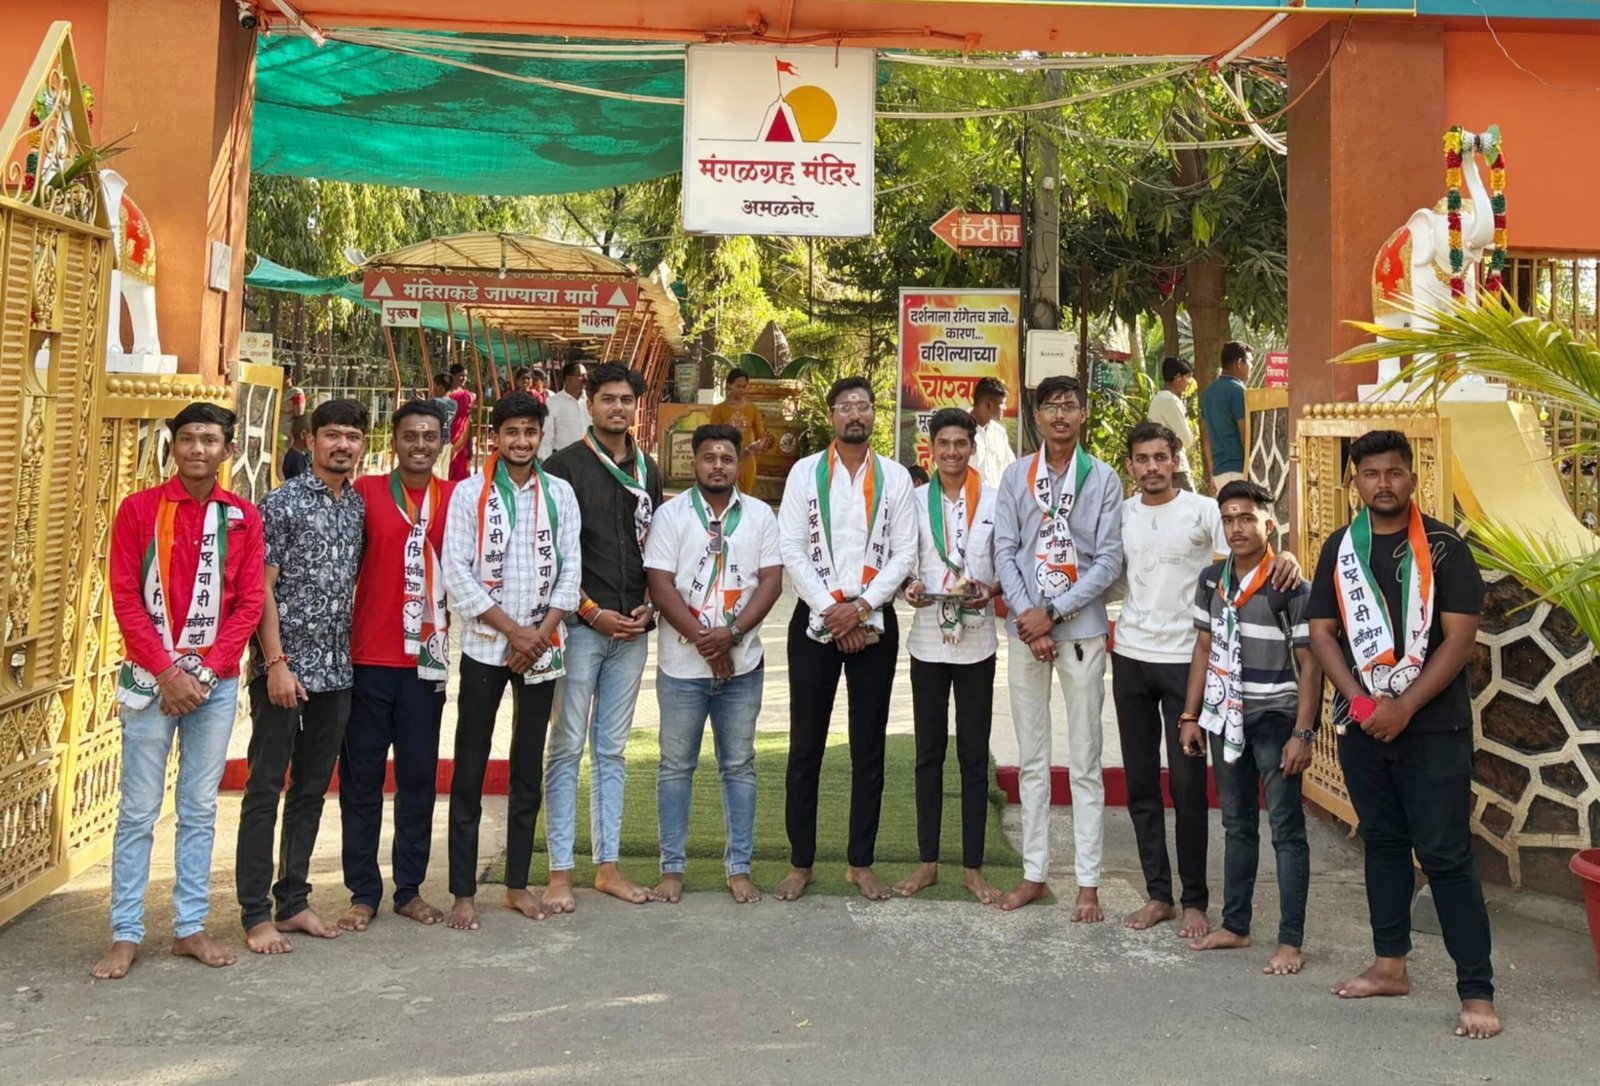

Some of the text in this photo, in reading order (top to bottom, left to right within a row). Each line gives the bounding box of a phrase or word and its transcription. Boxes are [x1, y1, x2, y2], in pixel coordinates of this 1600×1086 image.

[698, 153, 861, 186] मंगळग्रह मंदिर
[741, 195, 819, 218] अमळनेर
[403, 277, 598, 305] मंदिराकडे जाण्याचा मार्ग
[581, 310, 615, 327] महिला
[910, 306, 950, 323] दर्शनाला
[952, 307, 986, 323] रांगेतच
[921, 341, 997, 363] वशिल्याच्या
[919, 367, 977, 403] चोरवा
[185, 613, 214, 628] काँग्रेस
